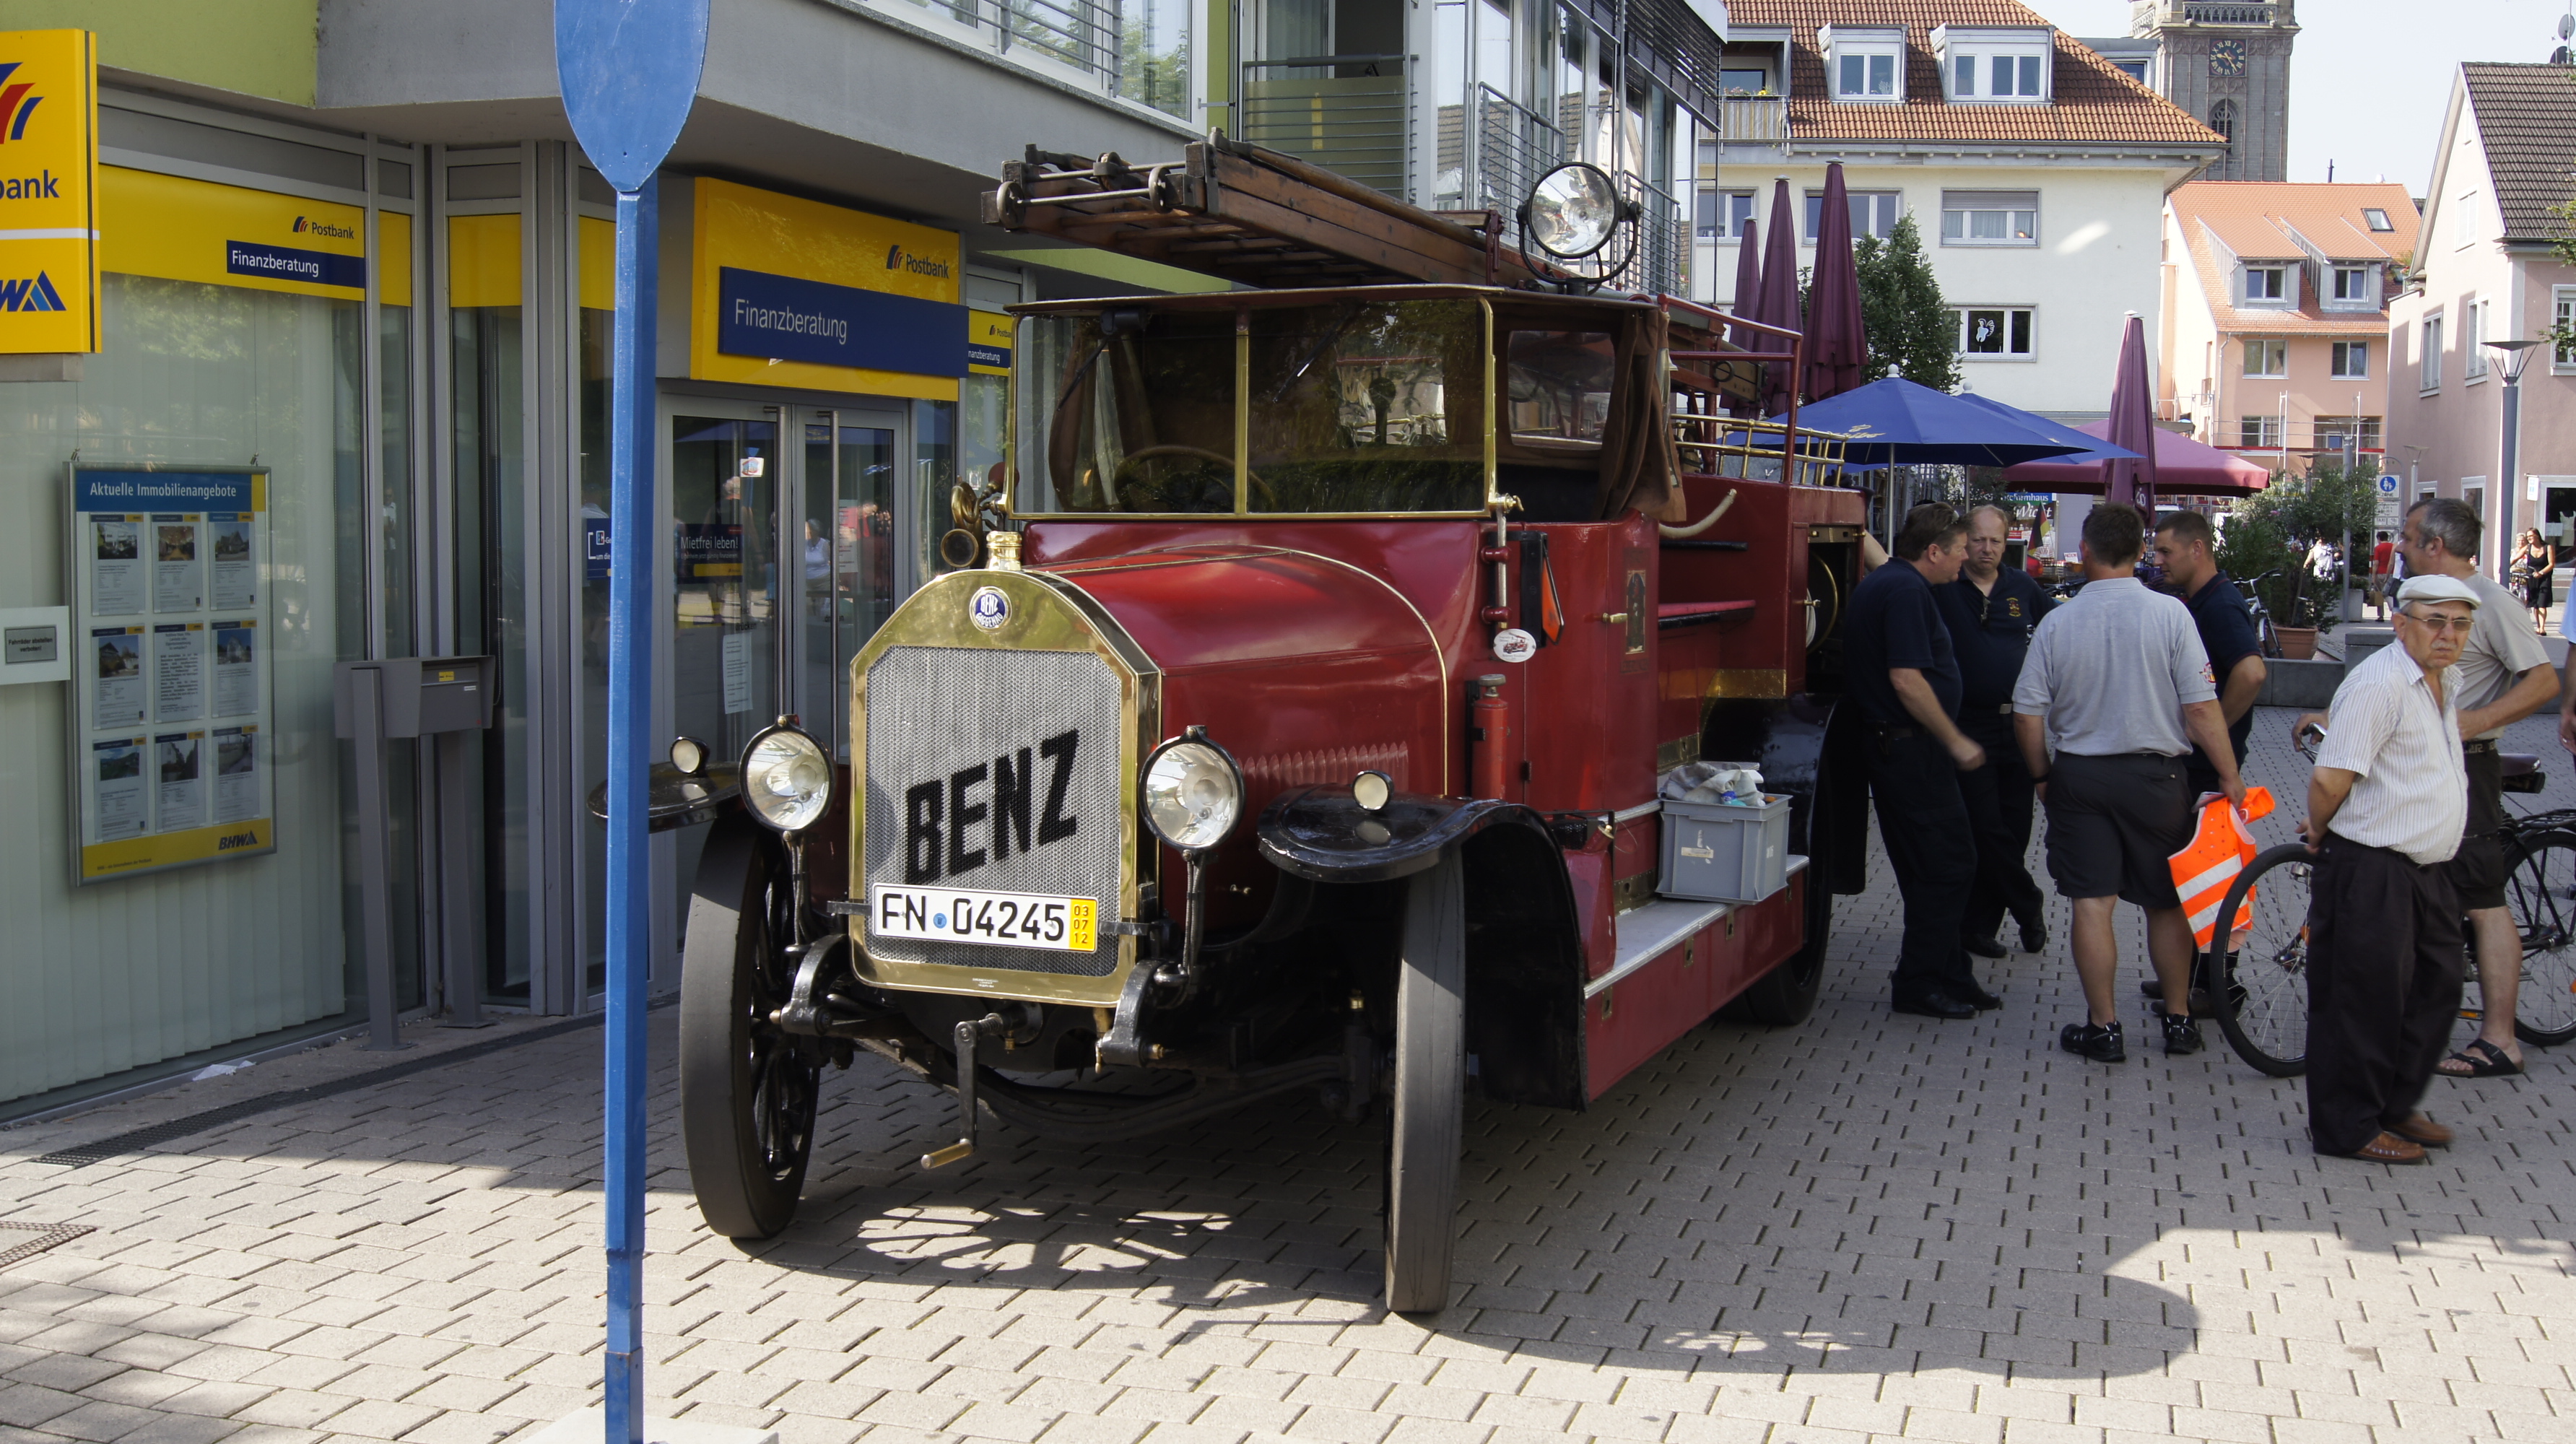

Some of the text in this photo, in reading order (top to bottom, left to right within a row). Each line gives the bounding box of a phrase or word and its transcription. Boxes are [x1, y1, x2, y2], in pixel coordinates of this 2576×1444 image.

[312, 222, 354, 240] Postbank
[232, 250, 319, 278] Finanzberatung
[906, 253, 949, 279] Postbank
[735, 298, 848, 345] Finanzberatung
[90, 482, 236, 500] Aktuelle Immobilienangebote
[2016, 502, 2052, 518] Wict
[681, 536, 739, 549] Mietfrei leben!
[980, 594, 998, 615] BENZ
[975, 612, 1004, 627] GAGGENAU
[905, 730, 1079, 884] BENZ
[882, 893, 1064, 941] FN 04245
[1074, 905, 1089, 916] 03
[1074, 919, 1089, 930] 07
[1074, 933, 1089, 944] 12
